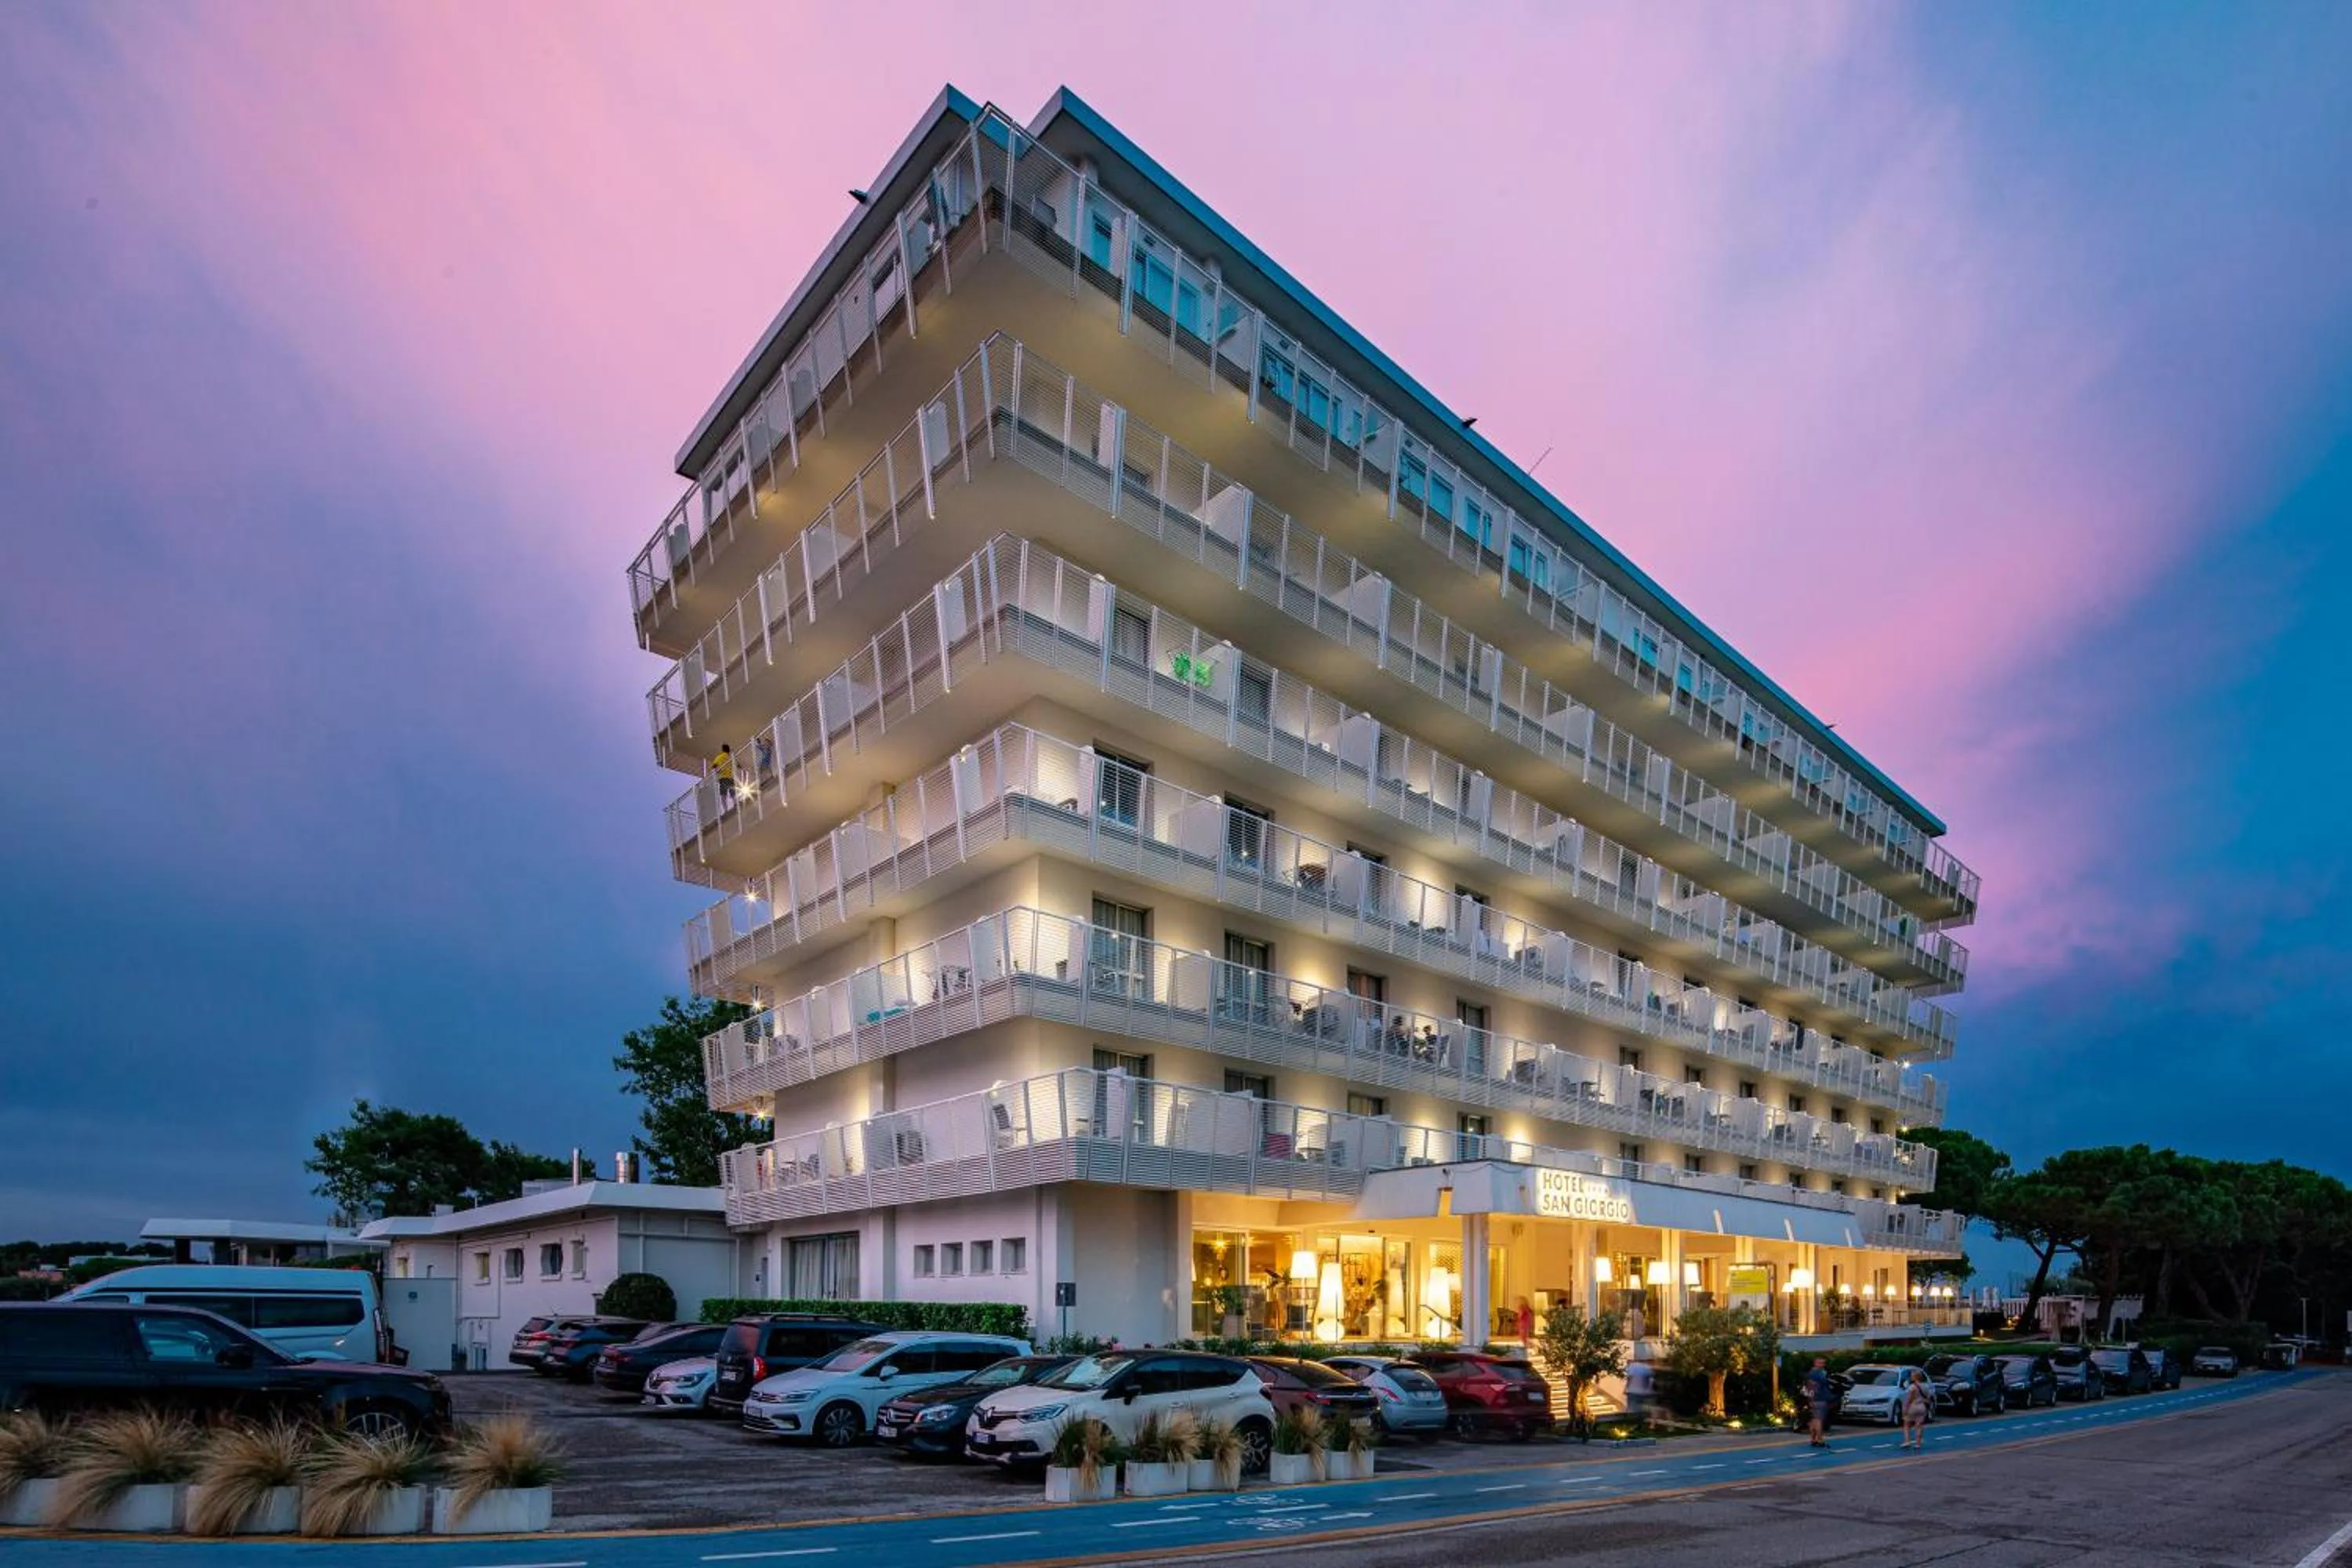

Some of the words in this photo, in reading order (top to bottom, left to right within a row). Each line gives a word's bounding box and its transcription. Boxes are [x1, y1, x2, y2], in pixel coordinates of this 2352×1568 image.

[1542, 1172, 1584, 1193] HOTEL
[1542, 1194, 1570, 1212] SAN
[1573, 1197, 1629, 1218] GIORGIO
